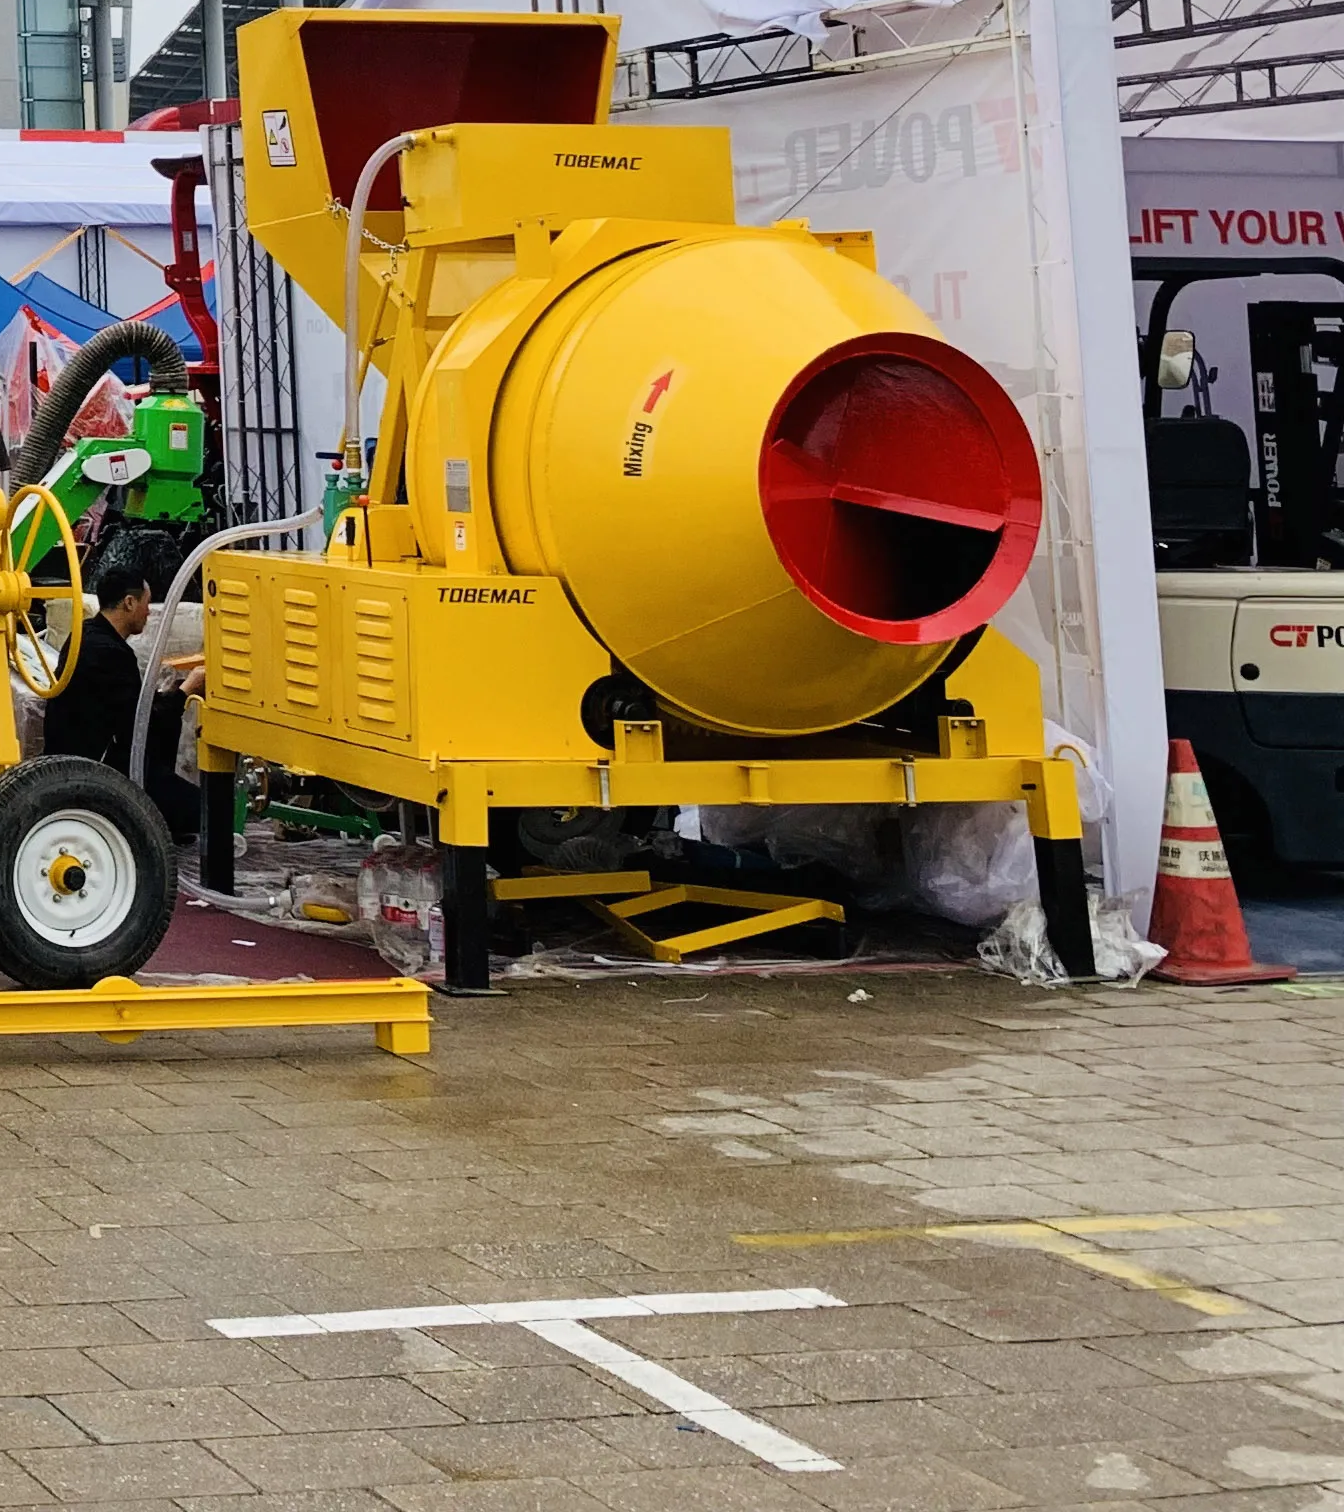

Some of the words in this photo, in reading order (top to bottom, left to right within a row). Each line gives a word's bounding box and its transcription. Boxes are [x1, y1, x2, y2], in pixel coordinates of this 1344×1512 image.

[553, 153, 643, 171] TOBEMAC
[1208, 210, 1327, 245] YOUR
[623, 421, 654, 477] Mixing
[437, 587, 537, 605] TOBEMAC
